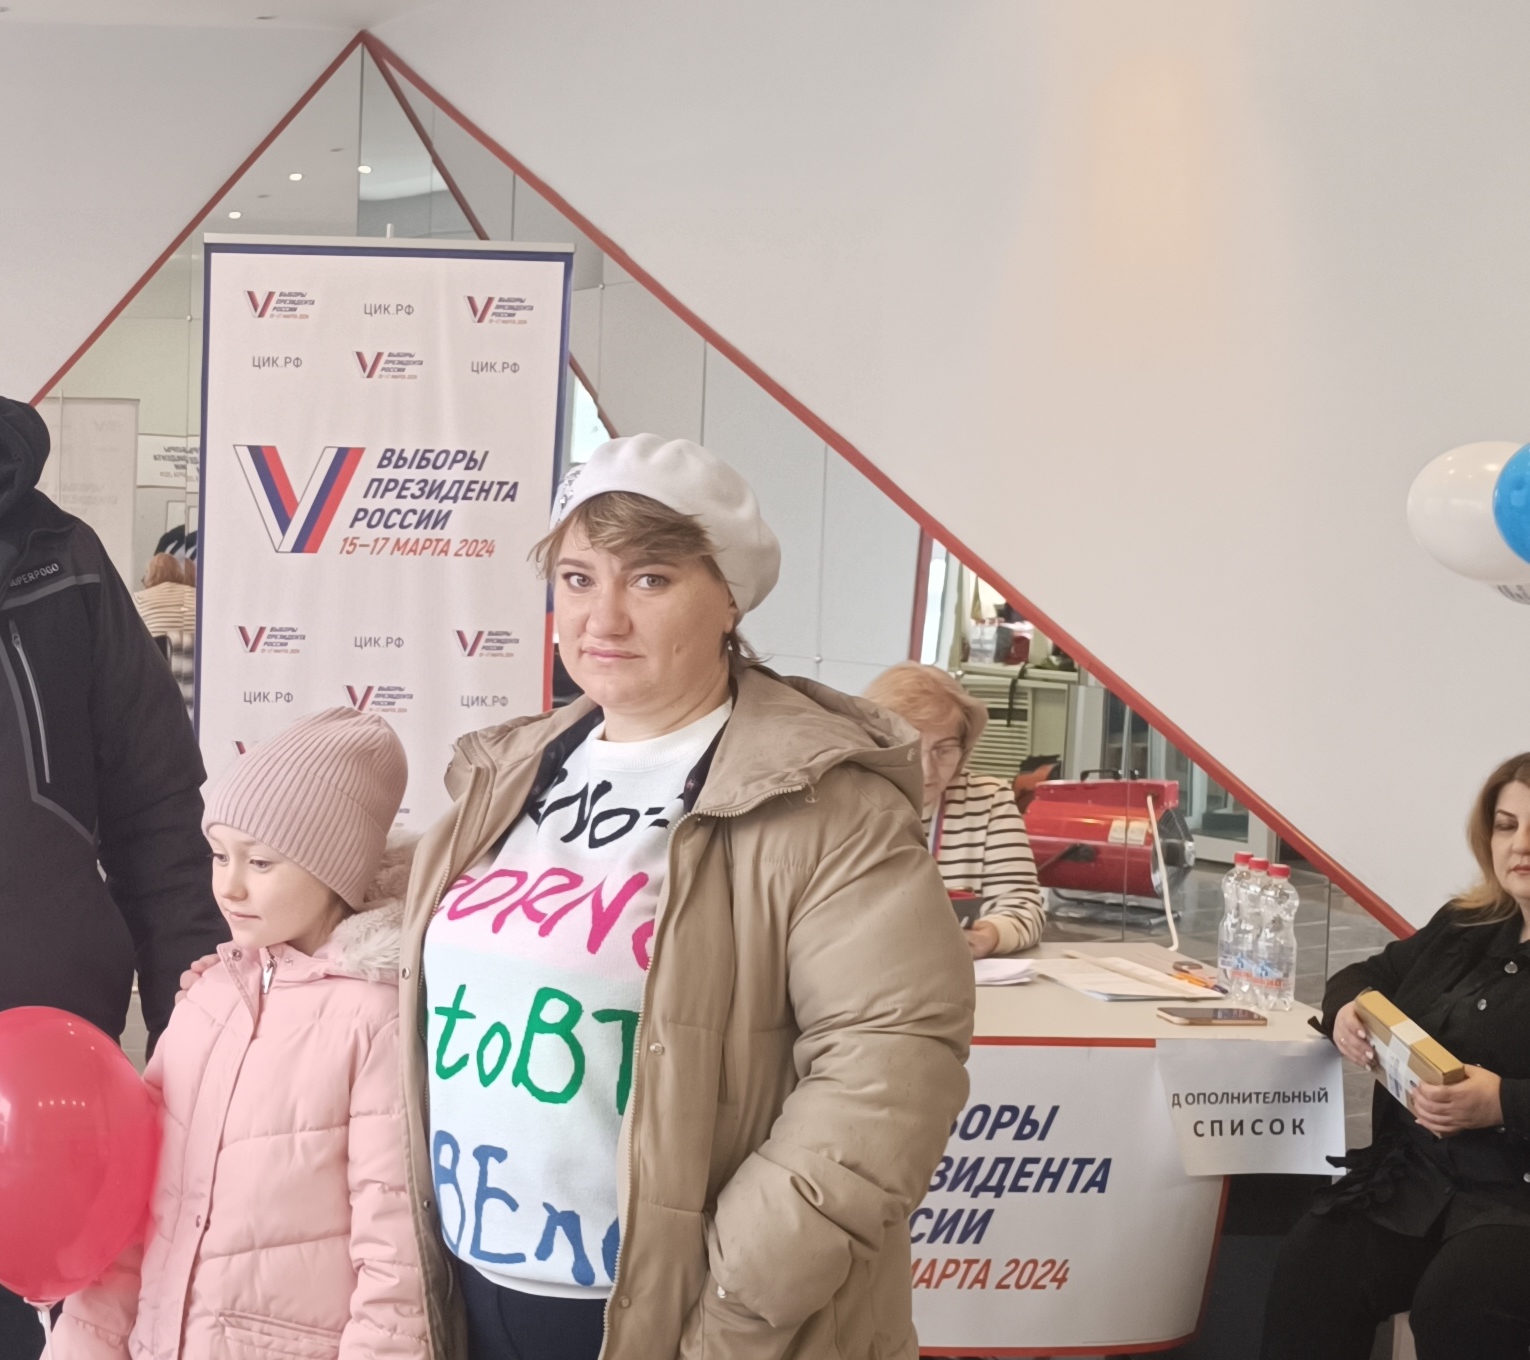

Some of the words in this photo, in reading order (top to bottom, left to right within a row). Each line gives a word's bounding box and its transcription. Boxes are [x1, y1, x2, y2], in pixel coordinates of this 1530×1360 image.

[363, 303, 415, 316] ЦИК.РФ
[252, 355, 303, 369] ЦИК.РФ
[470, 360, 520, 375] ЦИК.РФ
[376, 448, 489, 471] ВЫБОРЫ
[363, 478, 519, 504] ПРЕЗИДЕНТА
[349, 508, 453, 530] РОССИИ
[390, 538, 451, 557] МАРТА
[454, 539, 495, 558] 2024
[354, 635, 405, 649] ЦИК.РФ
[243, 690, 294, 704] ЦИК.РФ
[460, 695, 509, 708] ЦИК.РФ
[1193, 1118, 1305, 1137] СПИСОК
[928, 1155, 1112, 1198] ЗИДЕНТА
[995, 1258, 1070, 1290] 2024
